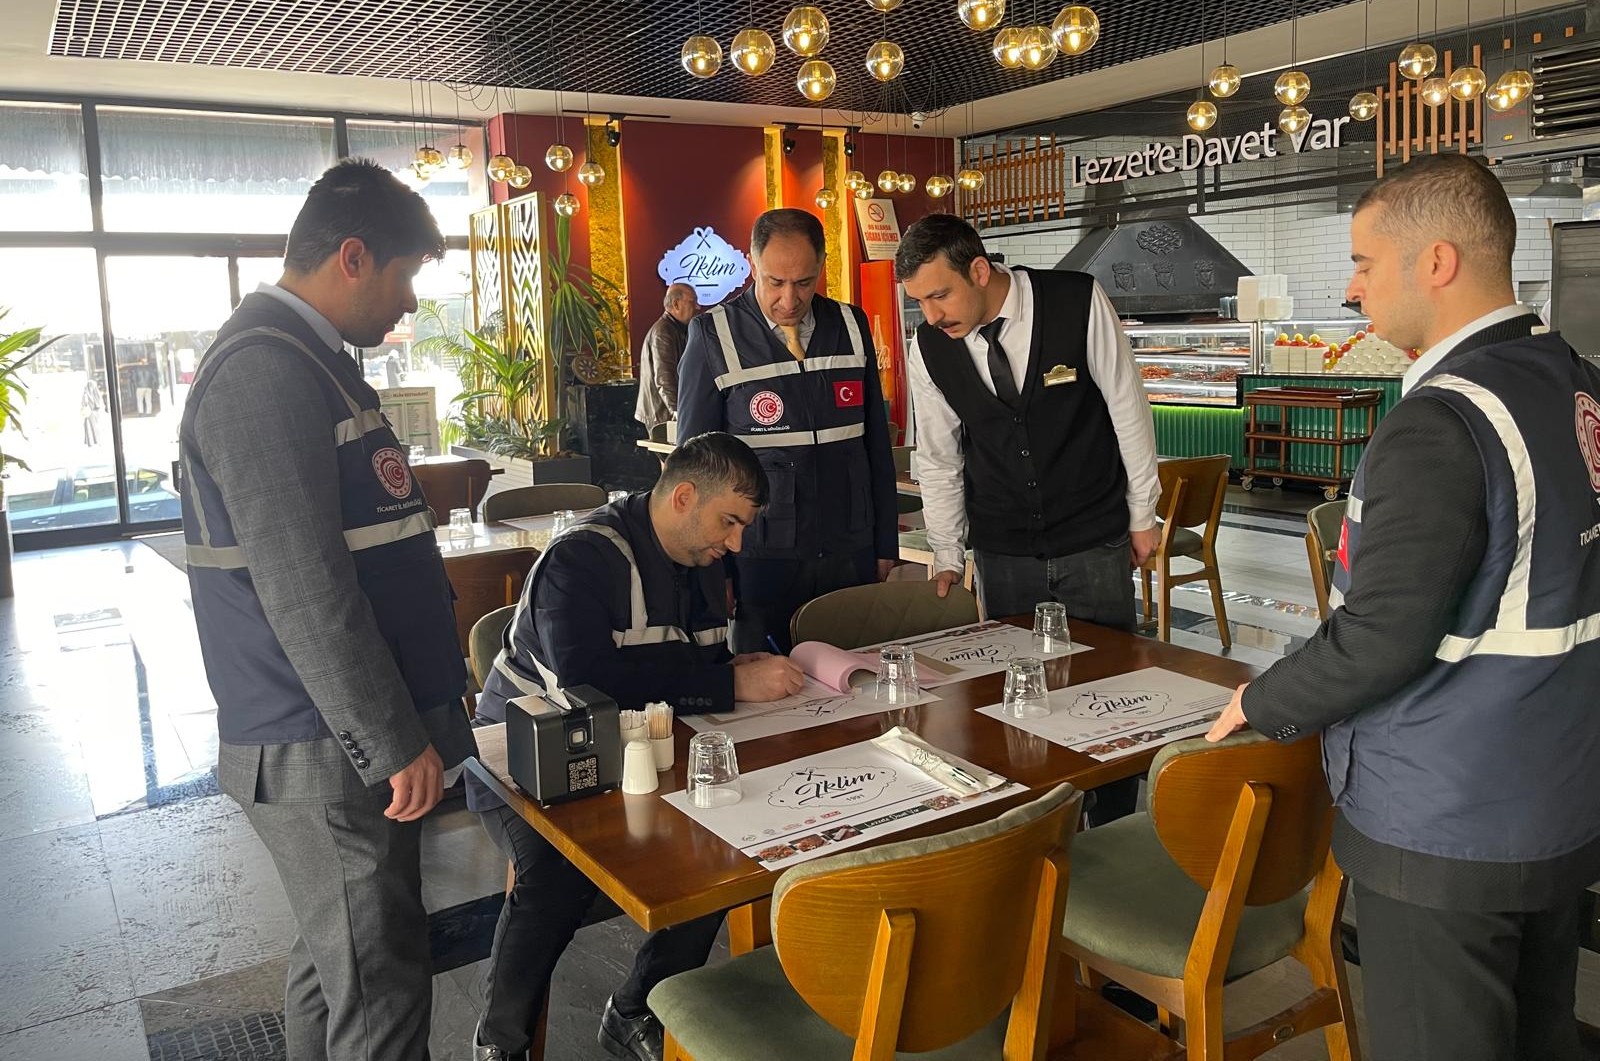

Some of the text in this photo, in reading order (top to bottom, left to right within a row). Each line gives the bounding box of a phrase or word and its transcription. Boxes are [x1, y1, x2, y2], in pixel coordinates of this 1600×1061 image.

[1071, 114, 1351, 187] Lezzet'e Davet Var
[376, 504, 398, 513] TİCARET
